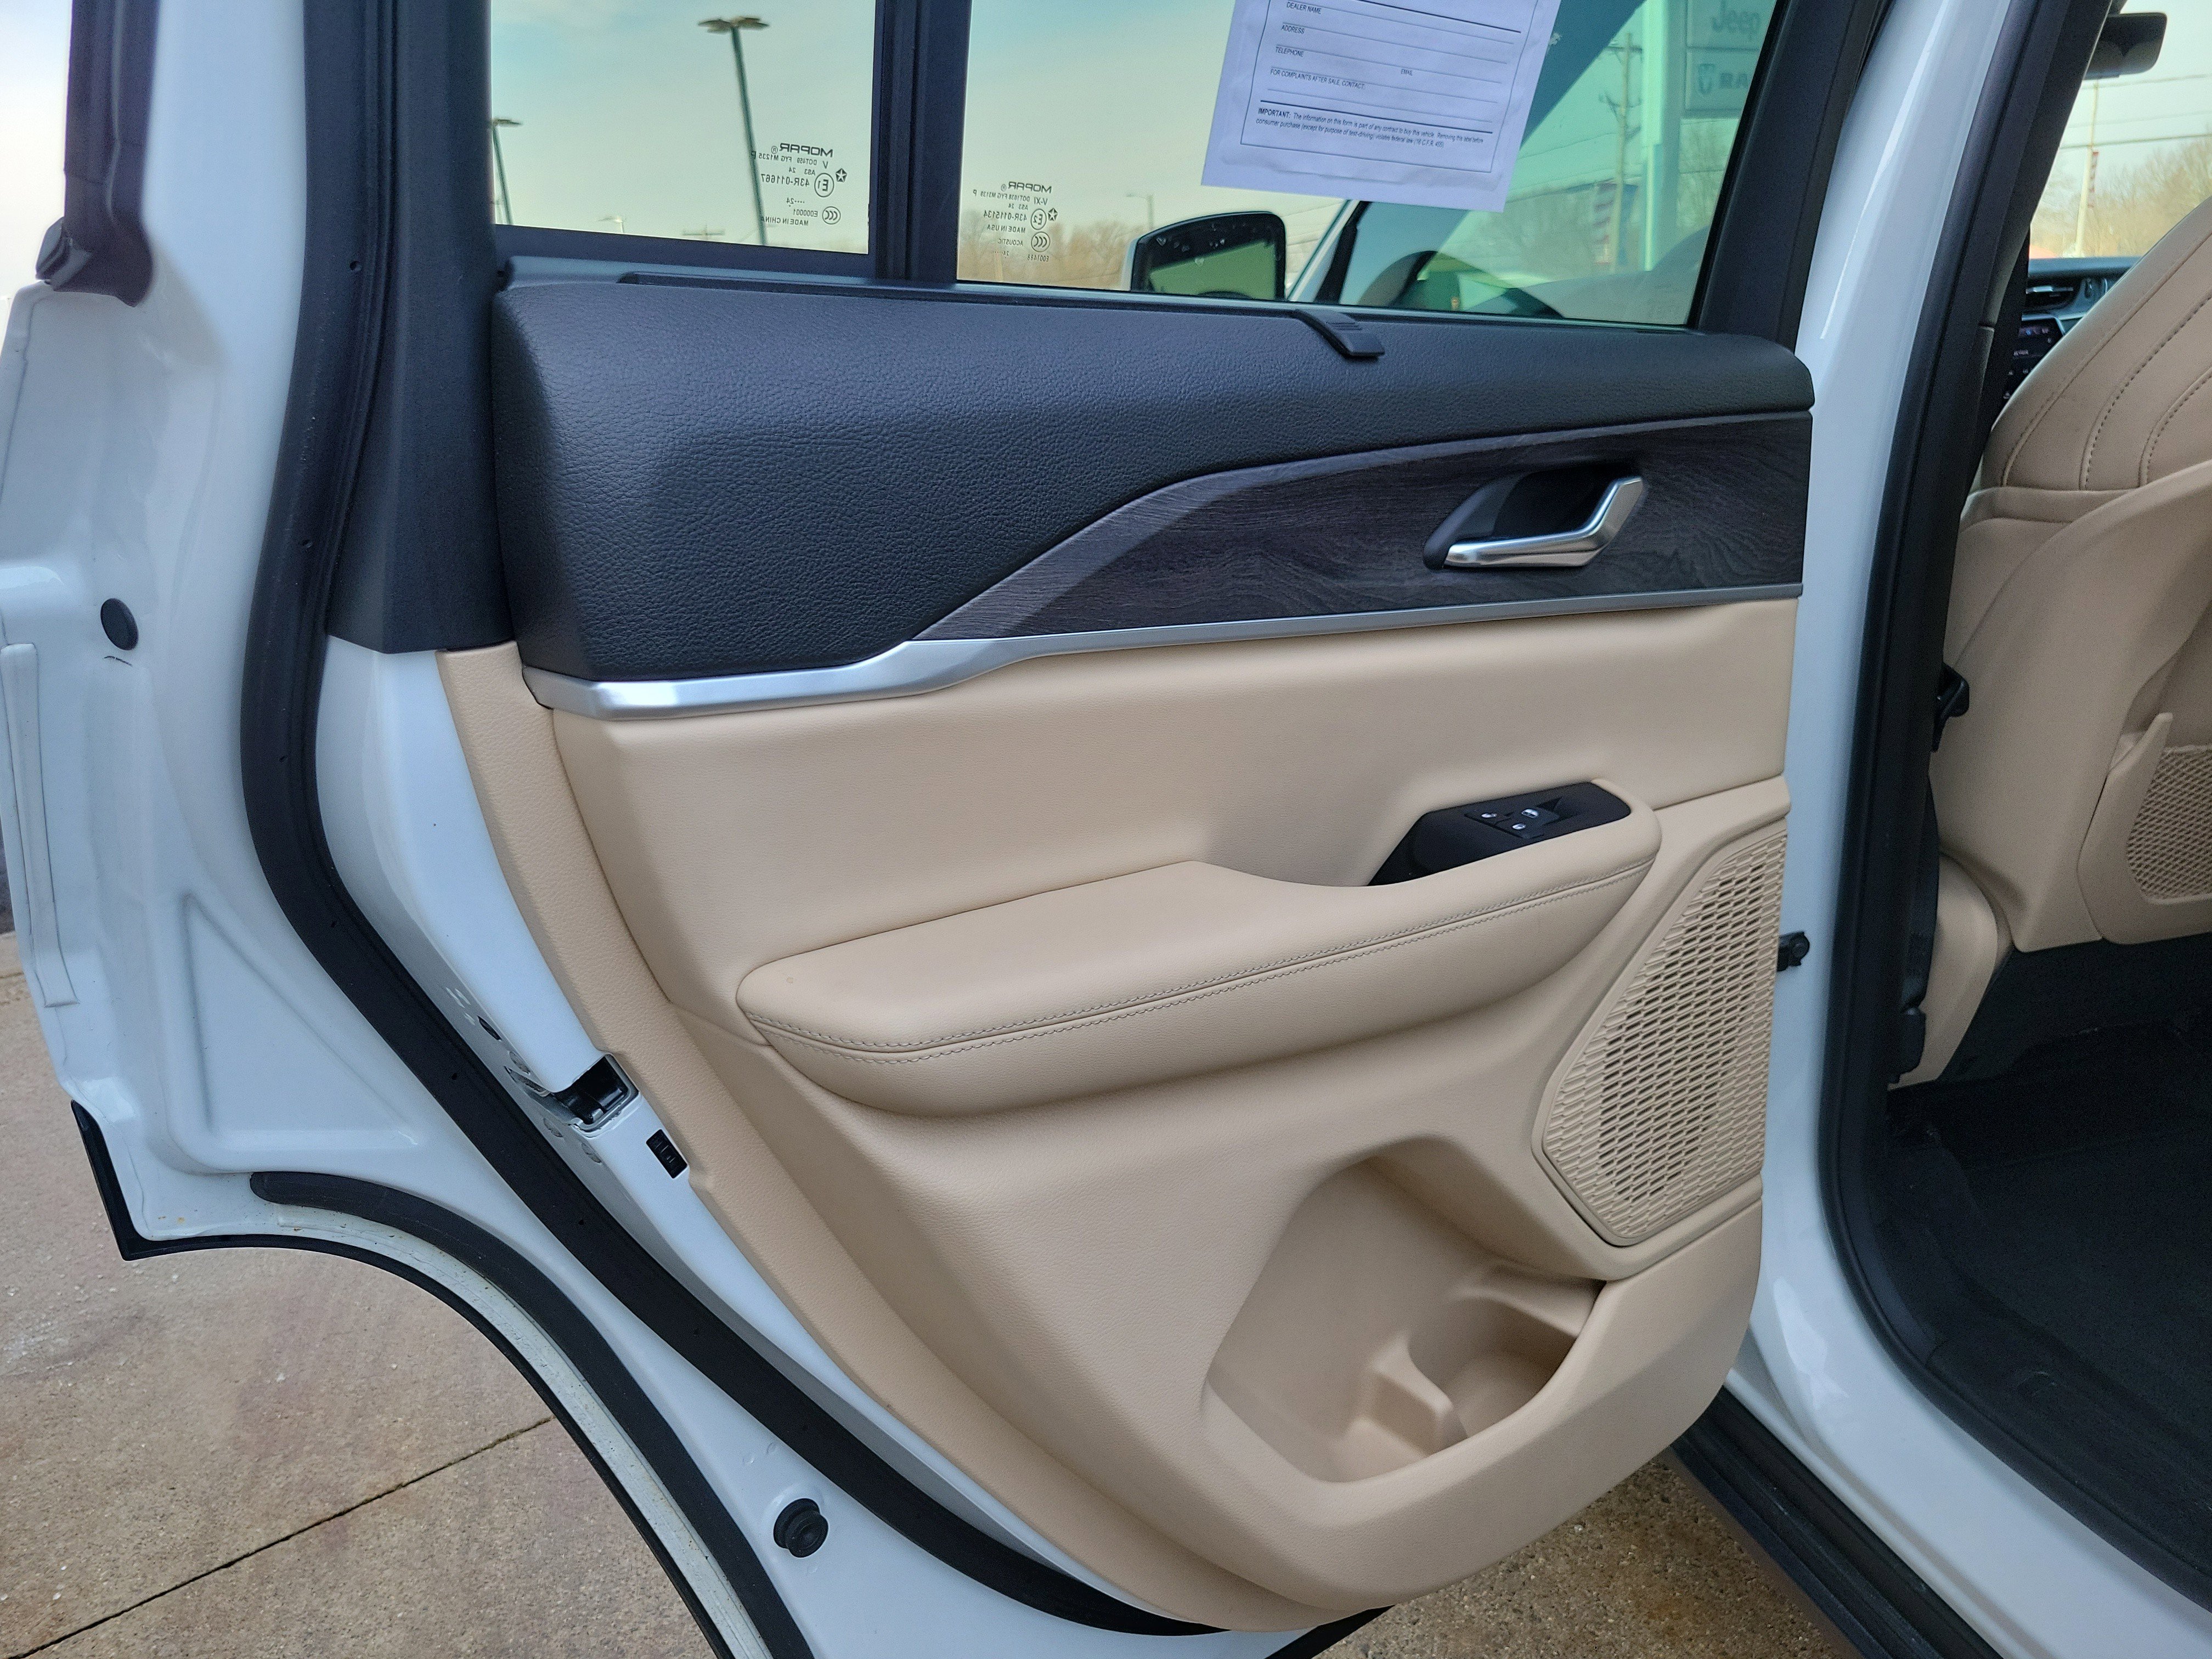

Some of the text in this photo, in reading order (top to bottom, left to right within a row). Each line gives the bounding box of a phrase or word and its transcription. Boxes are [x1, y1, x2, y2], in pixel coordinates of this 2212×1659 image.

[1286, 2, 1307, 12] DEALER
[1281, 25, 1305, 34] ADDRESS
[1276, 47, 1304, 57] TELEPHONE
[1281, 71, 1311, 81] COMPLAINTS
[1258, 108, 1290, 119] IMPORTANT:
[1302, 114, 1327, 123] information
[1279, 121, 1300, 129] purchase
